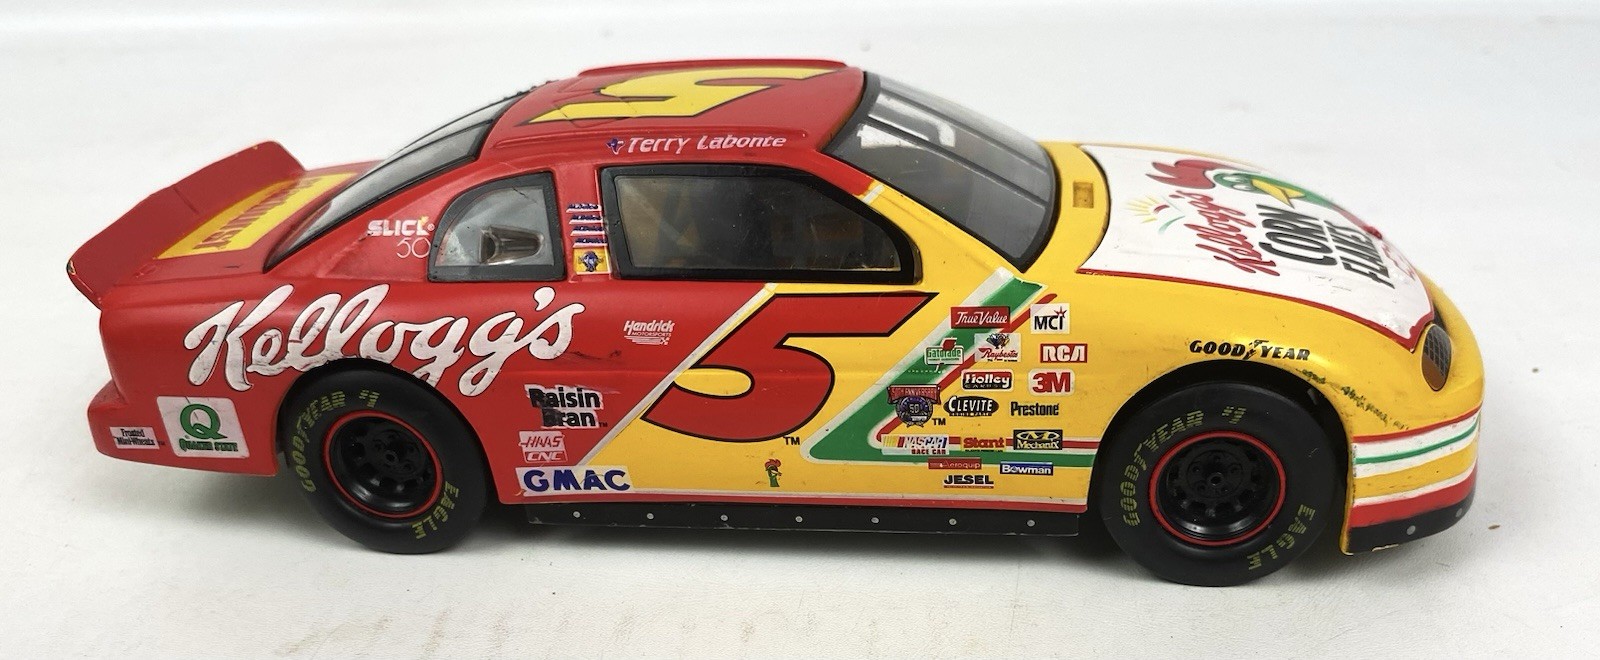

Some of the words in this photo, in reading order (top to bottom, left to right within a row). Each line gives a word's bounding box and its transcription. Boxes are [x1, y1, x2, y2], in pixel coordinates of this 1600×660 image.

[628, 137, 691, 154] Terry
[696, 134, 787, 150] Labonte
[1169, 190, 1280, 276] Kellogg's
[1256, 204, 1337, 266] CORN
[396, 236, 431, 258] 50
[1325, 220, 1395, 289] FLAKES
[623, 320, 676, 335] Hendrick
[1034, 315, 1063, 330] MCI
[184, 283, 586, 397] Kellogg's
[1043, 345, 1085, 361] RCA
[640, 291, 940, 443] 5
[965, 373, 1010, 388] Holley
[1032, 372, 1070, 393] 3M
[948, 396, 993, 412] CLEVITE
[1010, 401, 1060, 416] Prestone
[963, 437, 1005, 448] Stant
[526, 452, 562, 462] CNC
[1002, 463, 1052, 475] Bowman
[523, 470, 631, 492] GMAC
[943, 475, 994, 485] JESEL
[412, 481, 459, 539] EAGLE
[1247, 504, 1316, 570] EAGLE
